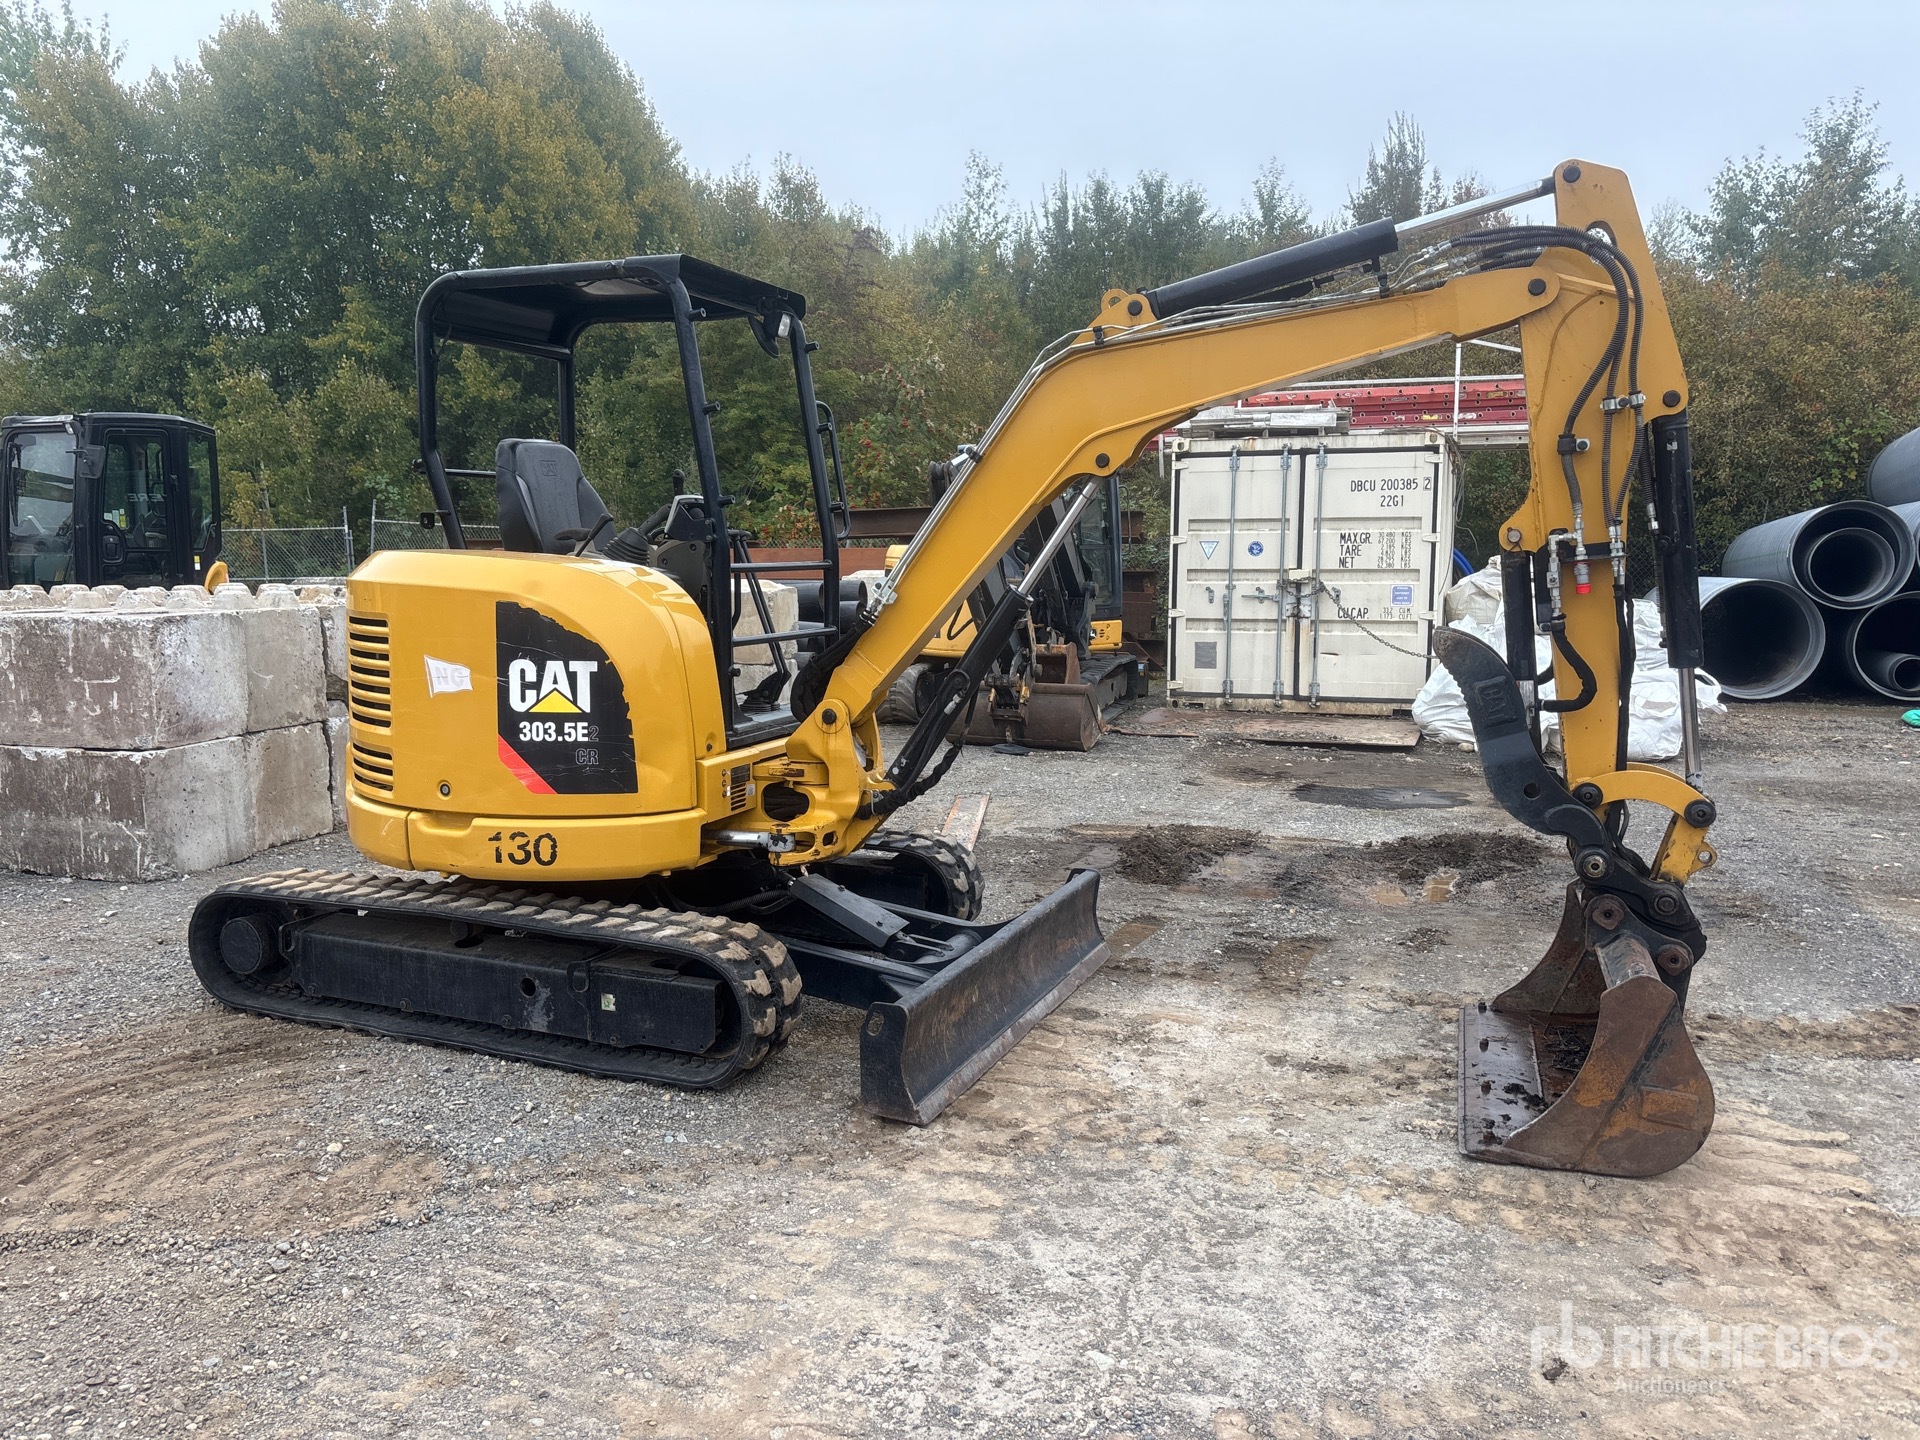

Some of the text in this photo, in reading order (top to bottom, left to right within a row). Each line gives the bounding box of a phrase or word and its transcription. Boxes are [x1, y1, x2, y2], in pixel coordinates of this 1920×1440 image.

[1351, 477, 1432, 492] DBCU 200385 2
[1380, 494, 1404, 507] 22G1
[1340, 545, 1363, 557] TARE
[1339, 557, 1355, 568] NET
[508, 659, 598, 713] CAT
[576, 748, 599, 765] CR
[488, 831, 558, 866] 130
